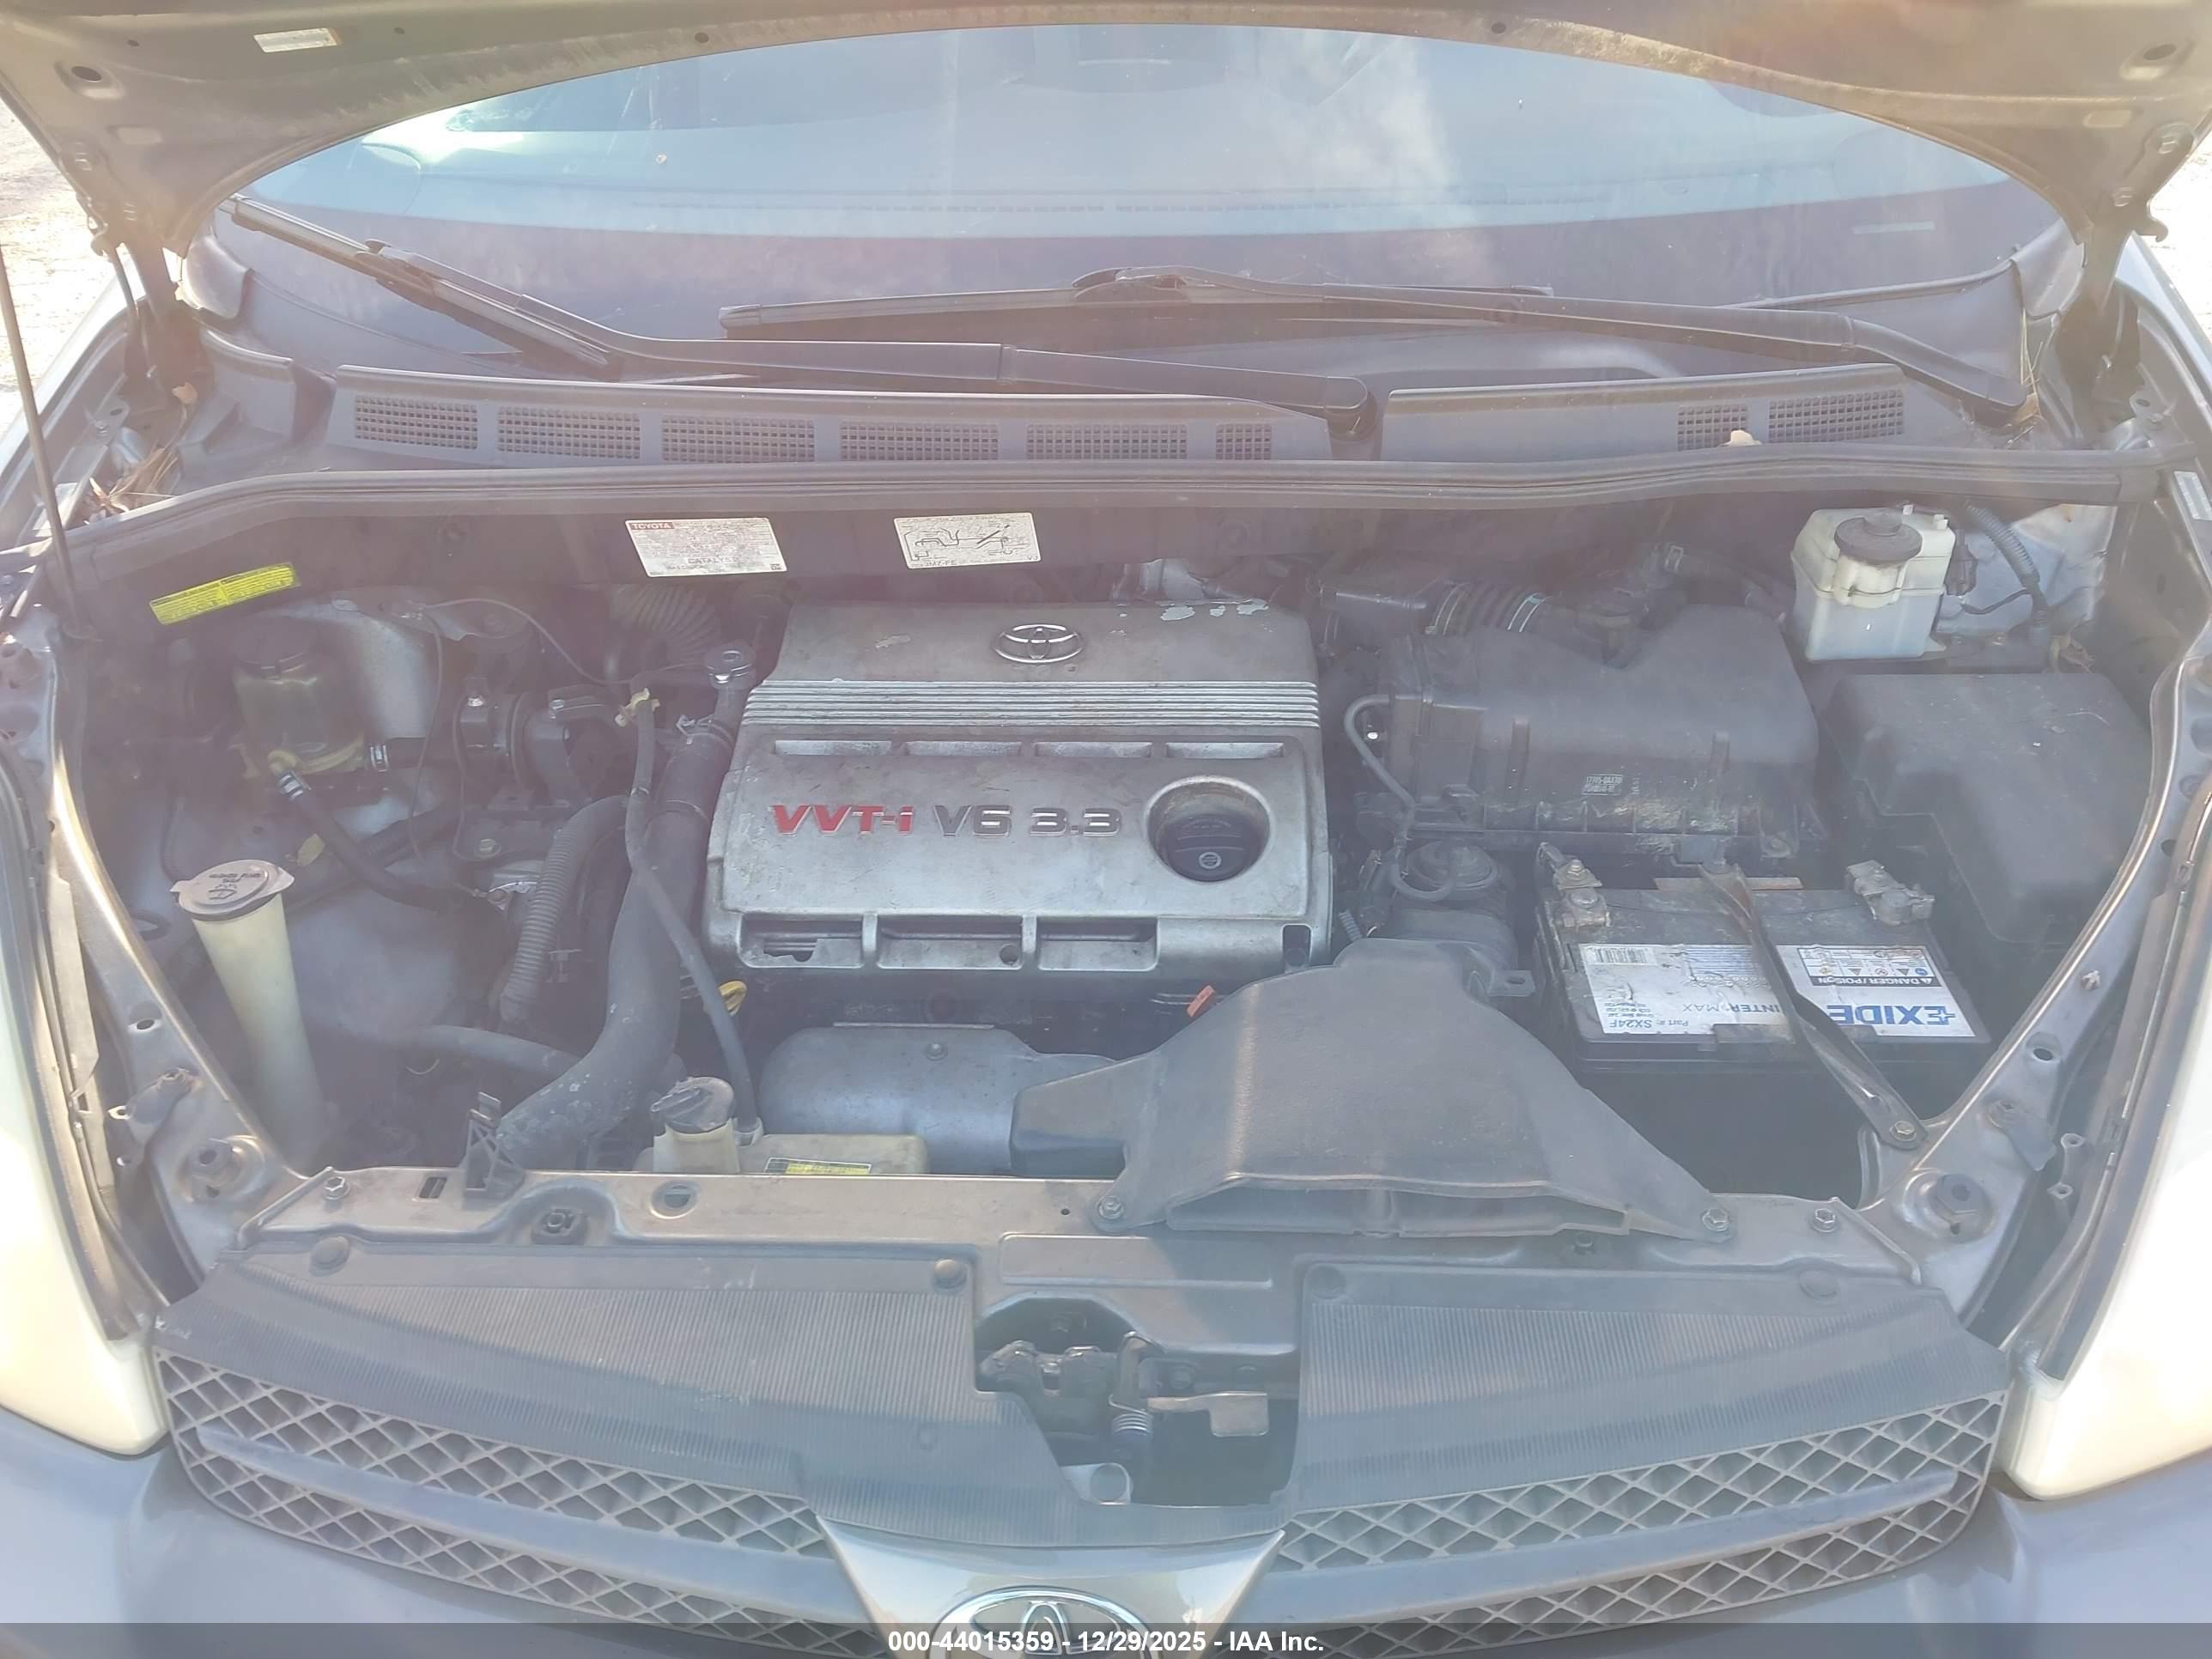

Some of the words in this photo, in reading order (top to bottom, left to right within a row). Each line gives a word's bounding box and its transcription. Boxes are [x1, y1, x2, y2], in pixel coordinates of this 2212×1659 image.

[769, 804, 915, 836] VVT-i
[933, 804, 1012, 838] V6
[1029, 806, 1123, 838] 3.3
[1818, 976, 1863, 985] POISON
[1682, 1003, 1719, 1013] MAX
[1826, 1005, 1956, 1026] EXIDE
[1608, 1019, 1653, 1029] SX24F
